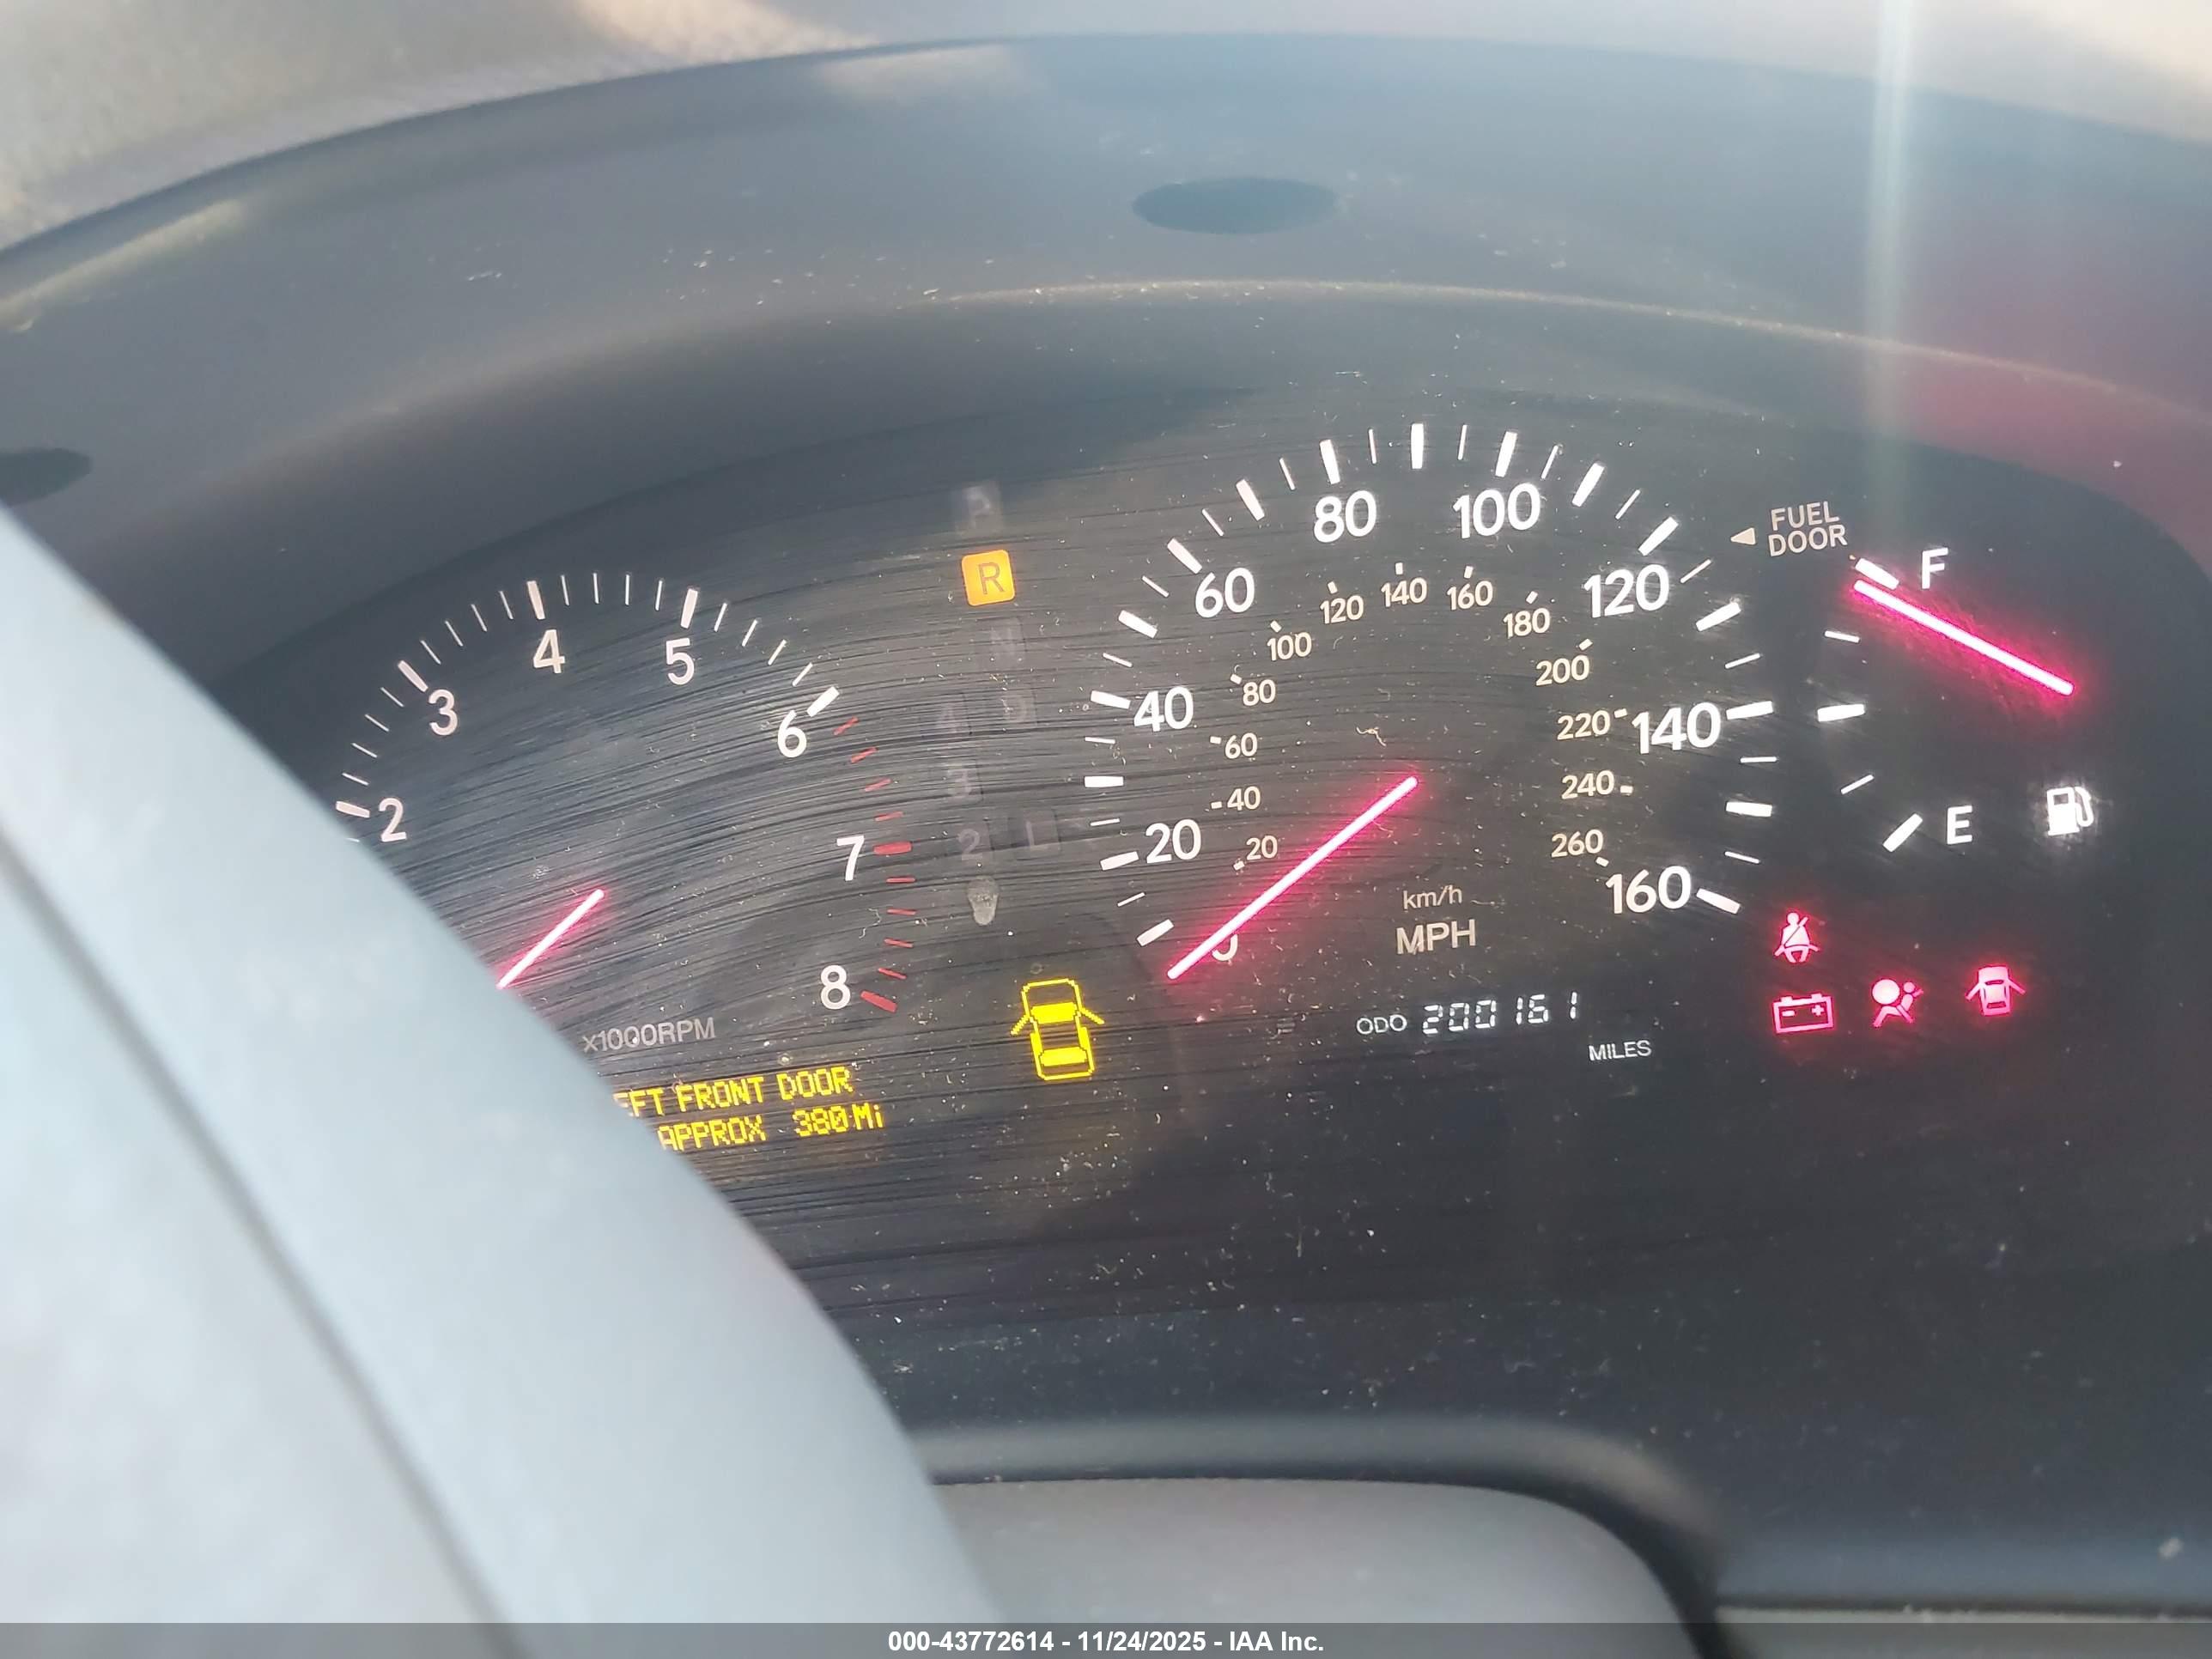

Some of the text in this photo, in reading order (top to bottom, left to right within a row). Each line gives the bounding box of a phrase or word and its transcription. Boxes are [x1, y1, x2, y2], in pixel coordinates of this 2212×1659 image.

[1313, 489, 1377, 543] 80
[1452, 482, 1544, 539] 100
[1771, 501, 1840, 532] FUEL
[1768, 524, 1848, 557] DOOR
[976, 562, 1006, 596] R
[1921, 547, 1949, 590] F
[1194, 566, 1255, 618] 60
[1381, 577, 1428, 607] 140
[1447, 580, 1493, 611] 160
[1583, 563, 1670, 618] 120
[1320, 594, 1364, 624] 120
[1503, 607, 1551, 638] 180
[532, 629, 566, 674] 4
[665, 637, 695, 685] 5
[1267, 631, 1312, 661] 100
[1535, 654, 1590, 686] 200
[1133, 684, 1194, 732] 40
[1243, 678, 1276, 707] 80
[428, 689, 459, 736] 3
[1557, 711, 1611, 740] 220
[1632, 702, 1723, 754] 140
[776, 709, 808, 758] 6
[1224, 732, 1258, 759] 60
[1227, 786, 1261, 811] 40
[1561, 771, 1615, 799] 240
[379, 797, 407, 842] 2
[1947, 805, 1973, 845] E
[836, 834, 866, 882] 7
[1146, 818, 1201, 864] 20
[1246, 835, 1278, 860] 20
[1551, 829, 1604, 858] 260
[1403, 884, 1462, 910] km/h
[1605, 866, 1692, 915] 160
[1396, 919, 1476, 955] MPH
[818, 964, 851, 1010] 8
[1356, 1013, 1408, 1035] ODO
[1422, 991, 1577, 1035] 200161
[1588, 1039, 1652, 1061] MILES
[676, 1076, 764, 1111] FRONT
[776, 1066, 854, 1100] DOOR
[657, 1115, 768, 1152] APPROX
